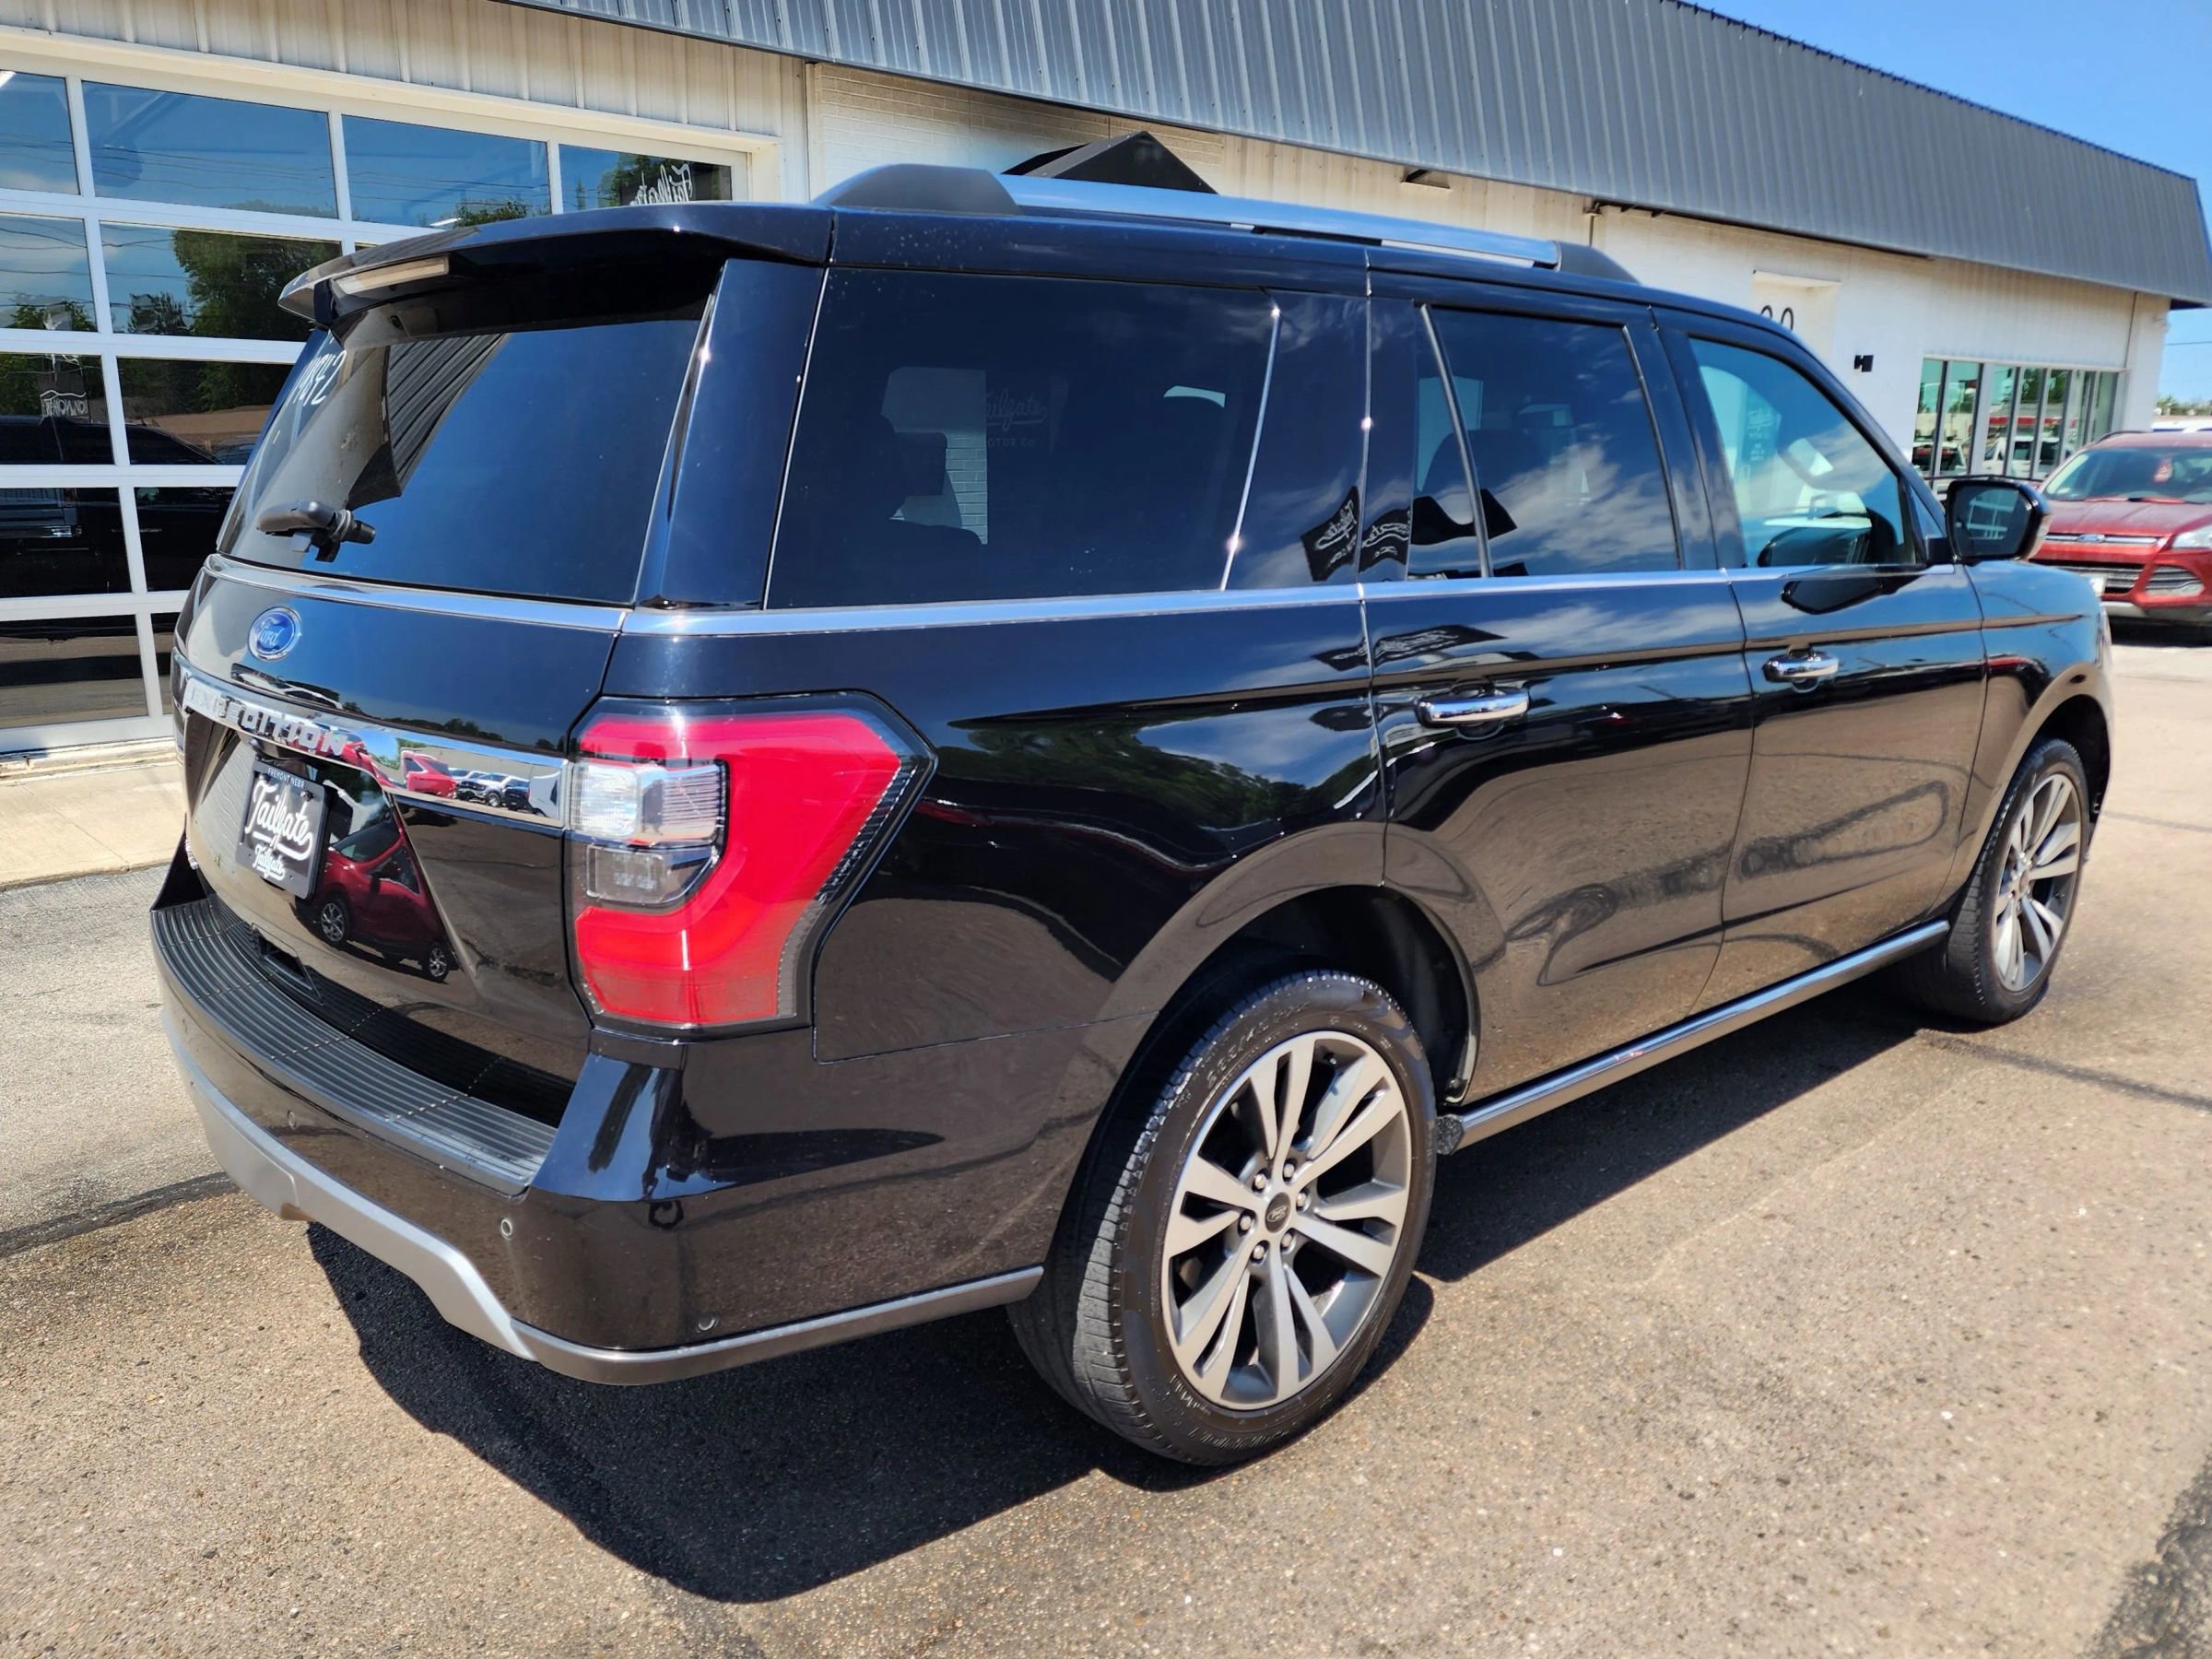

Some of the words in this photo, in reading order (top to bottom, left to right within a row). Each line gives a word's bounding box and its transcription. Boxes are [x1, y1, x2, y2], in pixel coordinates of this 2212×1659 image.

[267, 767, 291, 783] FREMONT
[244, 775, 313, 861] Tailgate
[252, 843, 286, 881] Tailgate
